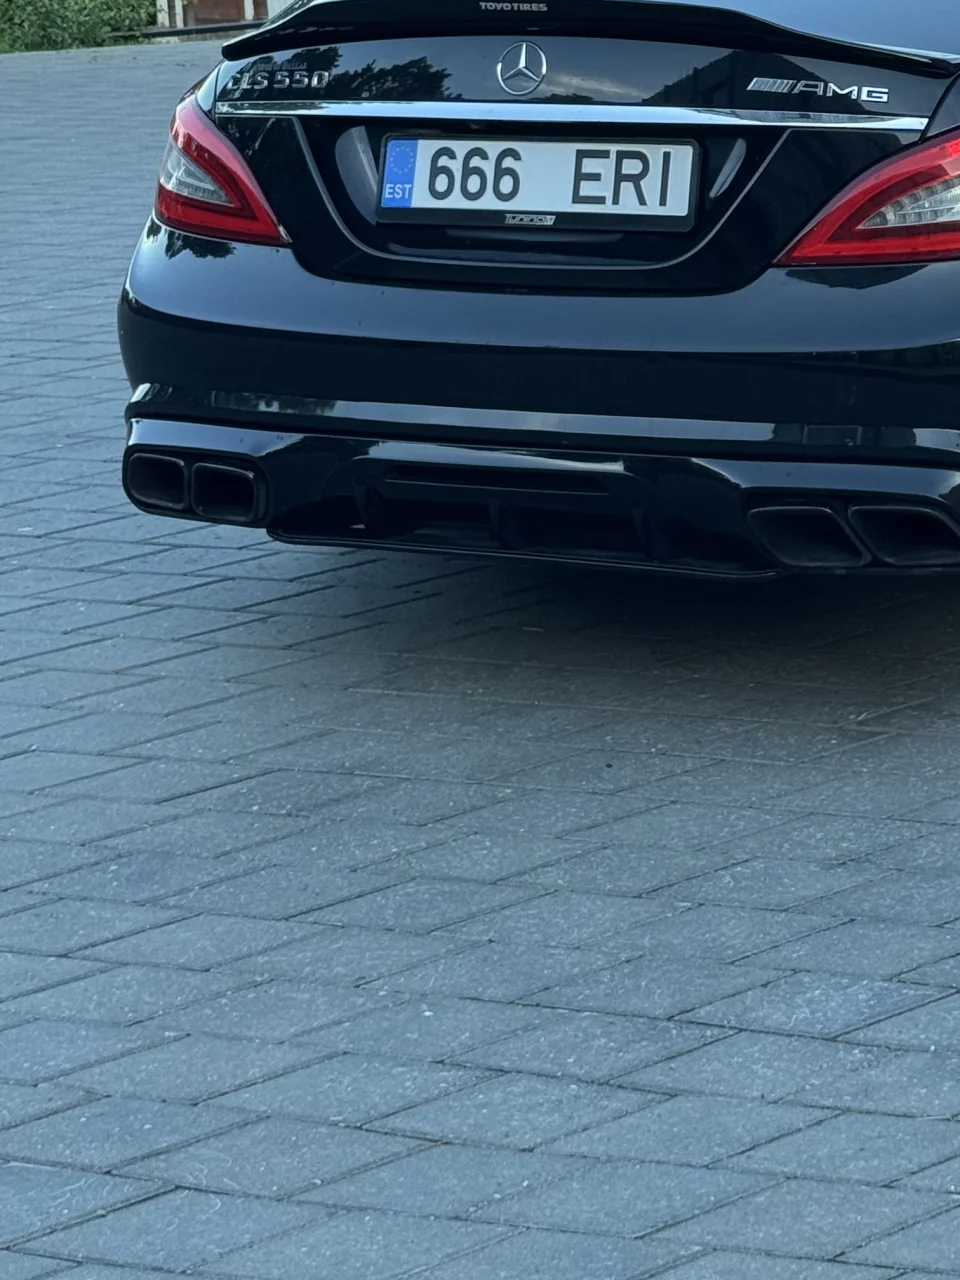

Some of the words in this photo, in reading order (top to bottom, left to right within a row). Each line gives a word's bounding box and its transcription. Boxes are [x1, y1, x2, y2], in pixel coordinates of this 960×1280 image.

[479, 1, 511, 11] TOYO
[511, 2, 548, 12] TIRES
[792, 80, 889, 102] AMG
[428, 146, 523, 202] 666
[571, 148, 671, 207] ERI
[385, 183, 412, 199] EST
